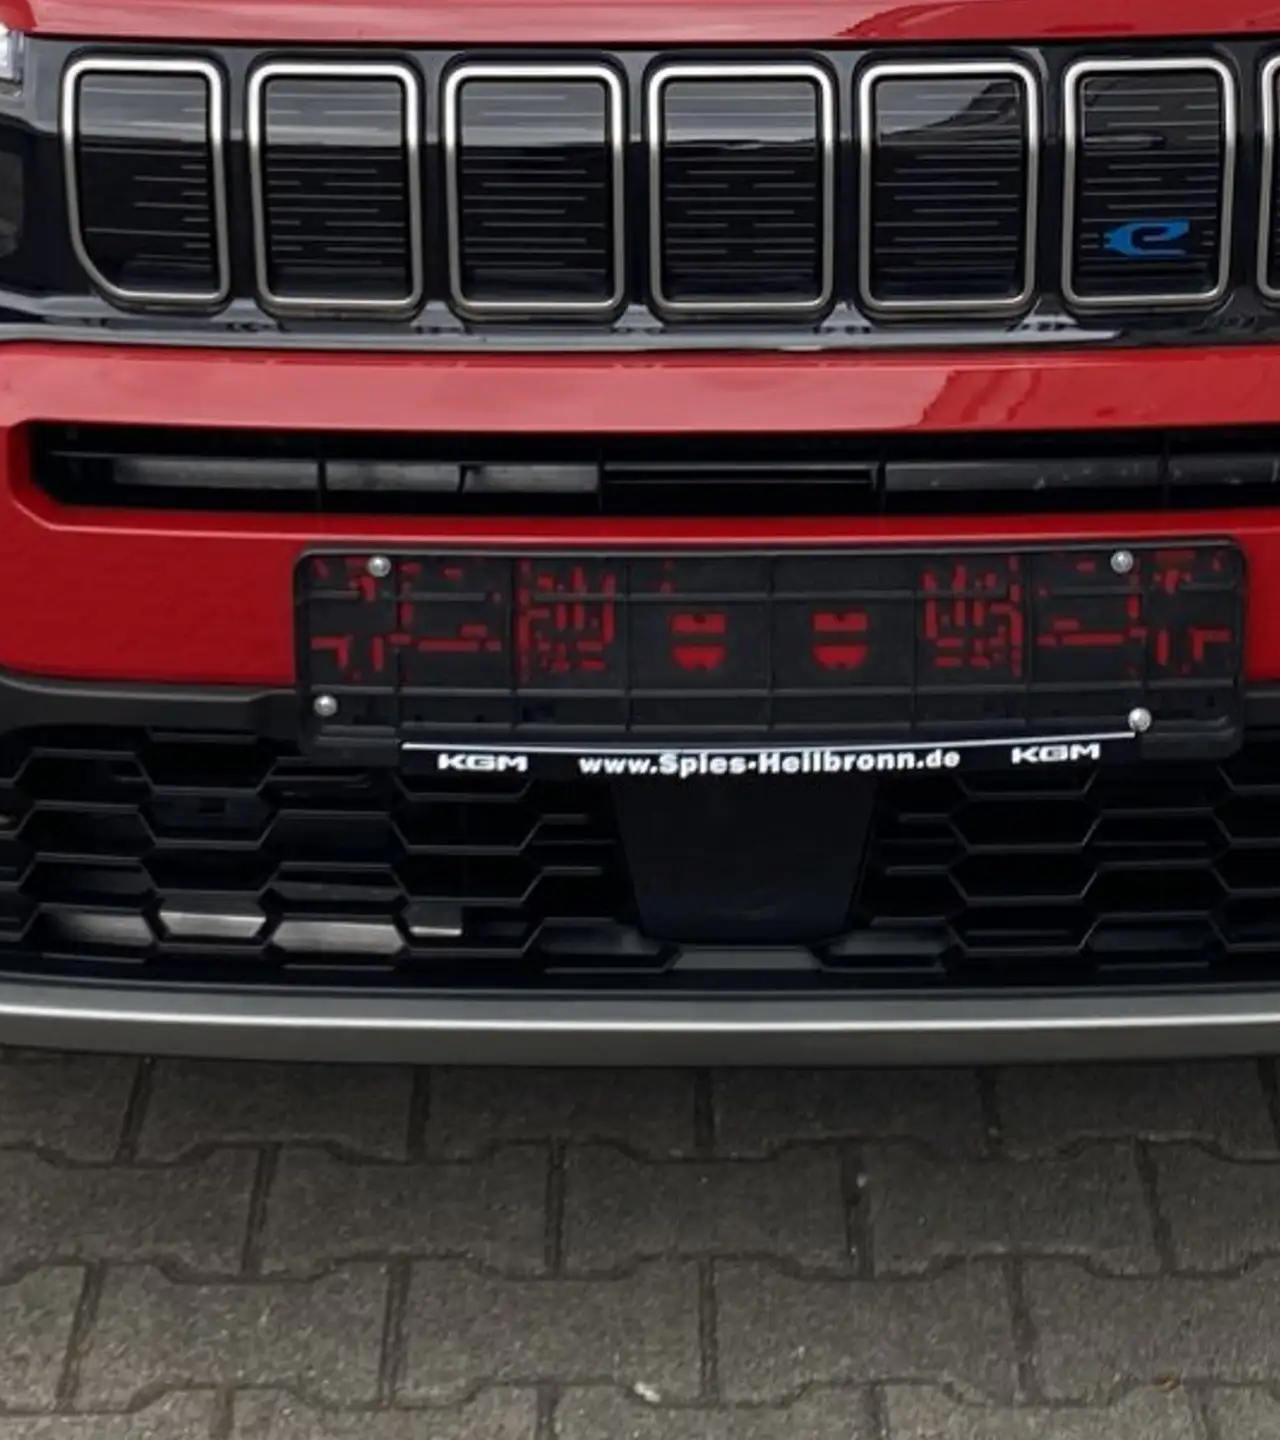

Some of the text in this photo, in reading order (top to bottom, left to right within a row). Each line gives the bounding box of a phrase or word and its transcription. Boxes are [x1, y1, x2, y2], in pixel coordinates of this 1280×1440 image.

[436, 753, 529, 771] KGM
[577, 749, 962, 779] www.Spies-Heilbronn.de
[1011, 743, 1101, 764] KGM
